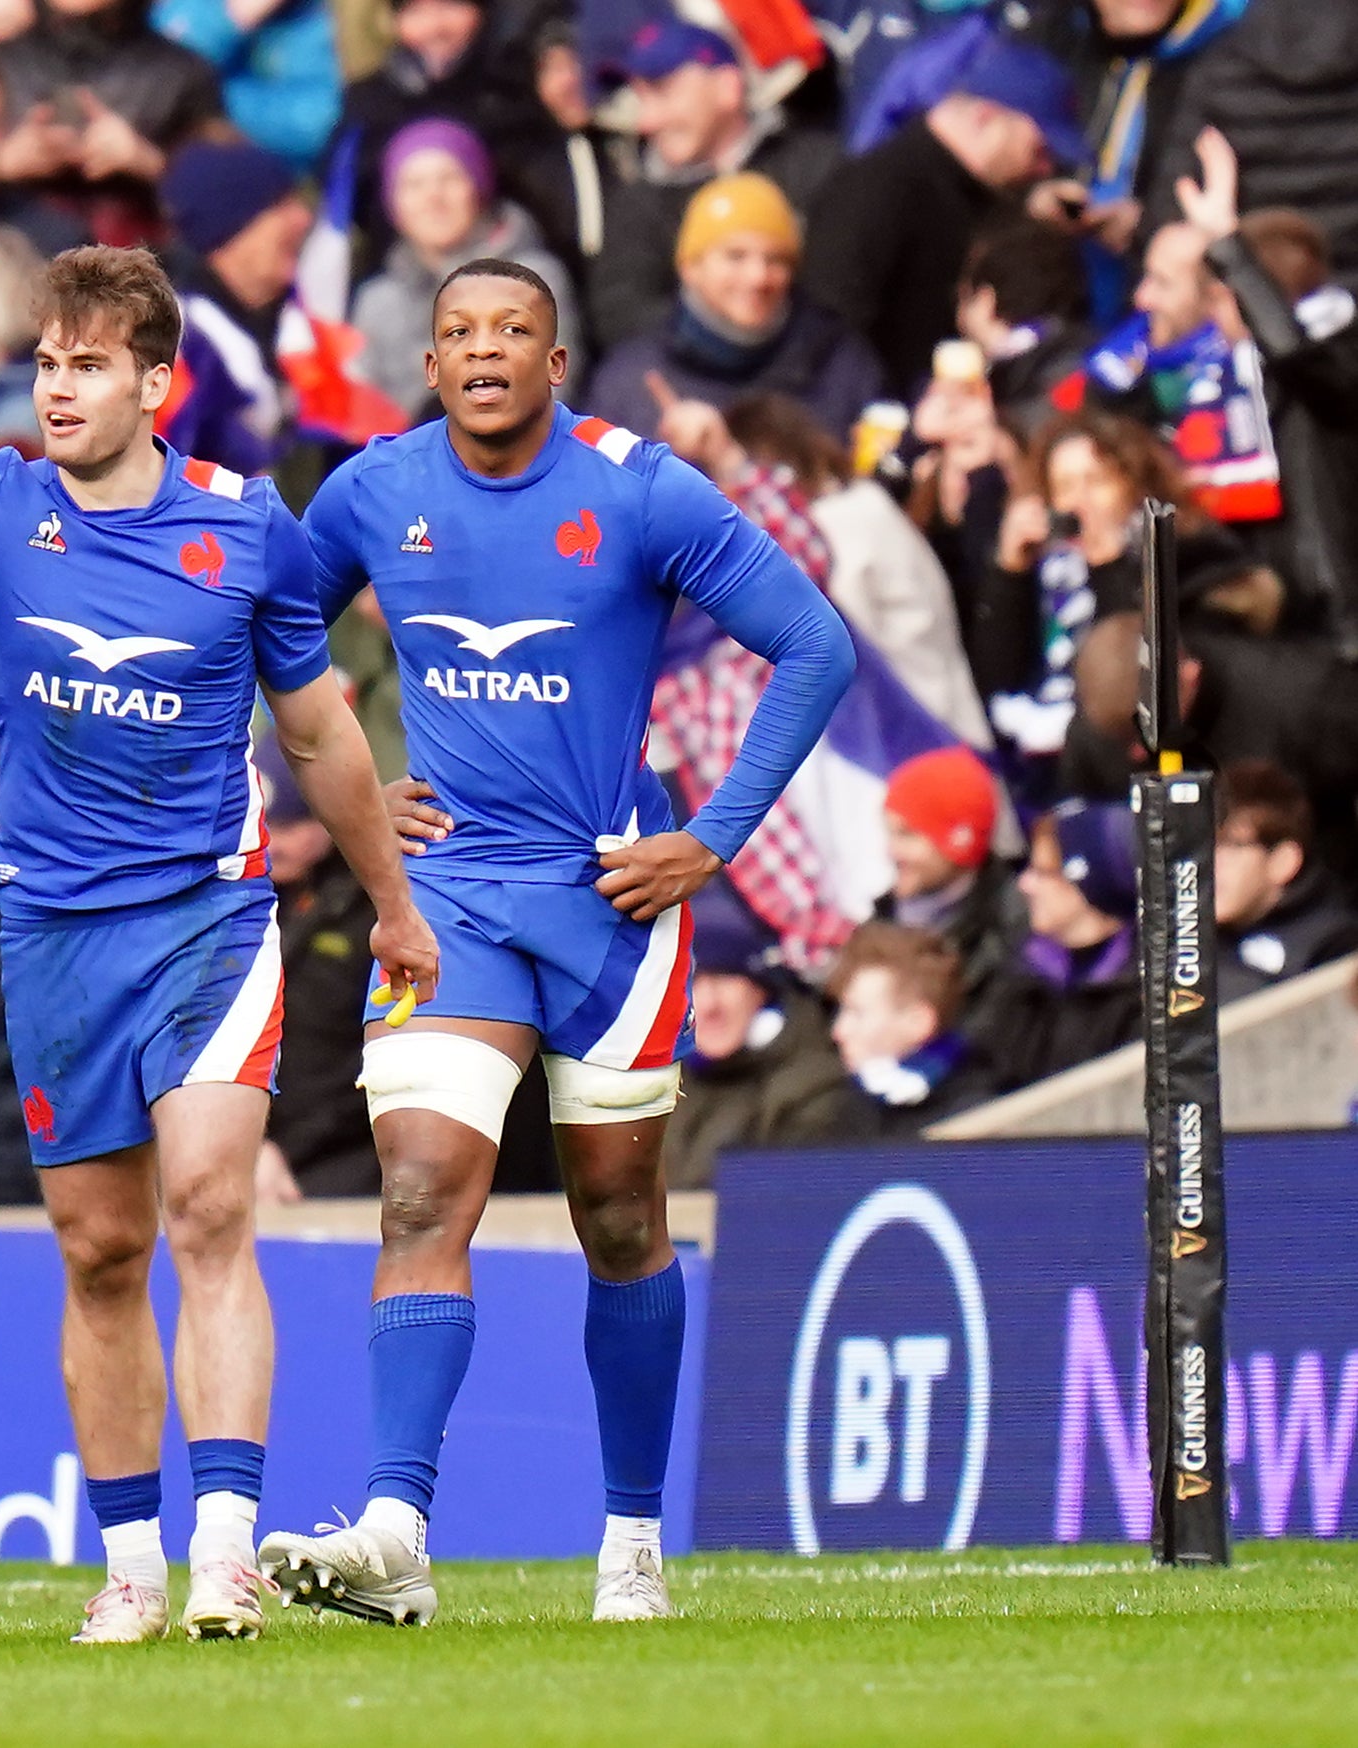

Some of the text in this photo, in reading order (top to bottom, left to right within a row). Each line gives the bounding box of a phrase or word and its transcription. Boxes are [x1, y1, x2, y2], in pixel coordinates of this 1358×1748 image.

[23, 670, 183, 722] ALTRAD
[424, 666, 571, 704] ALTRAD
[1174, 860, 1201, 988] GUINNESS
[1177, 1102, 1204, 1230] GUINNESS
[828, 1336, 951, 1505] BT
[1182, 1344, 1207, 1472] GUINNESS
